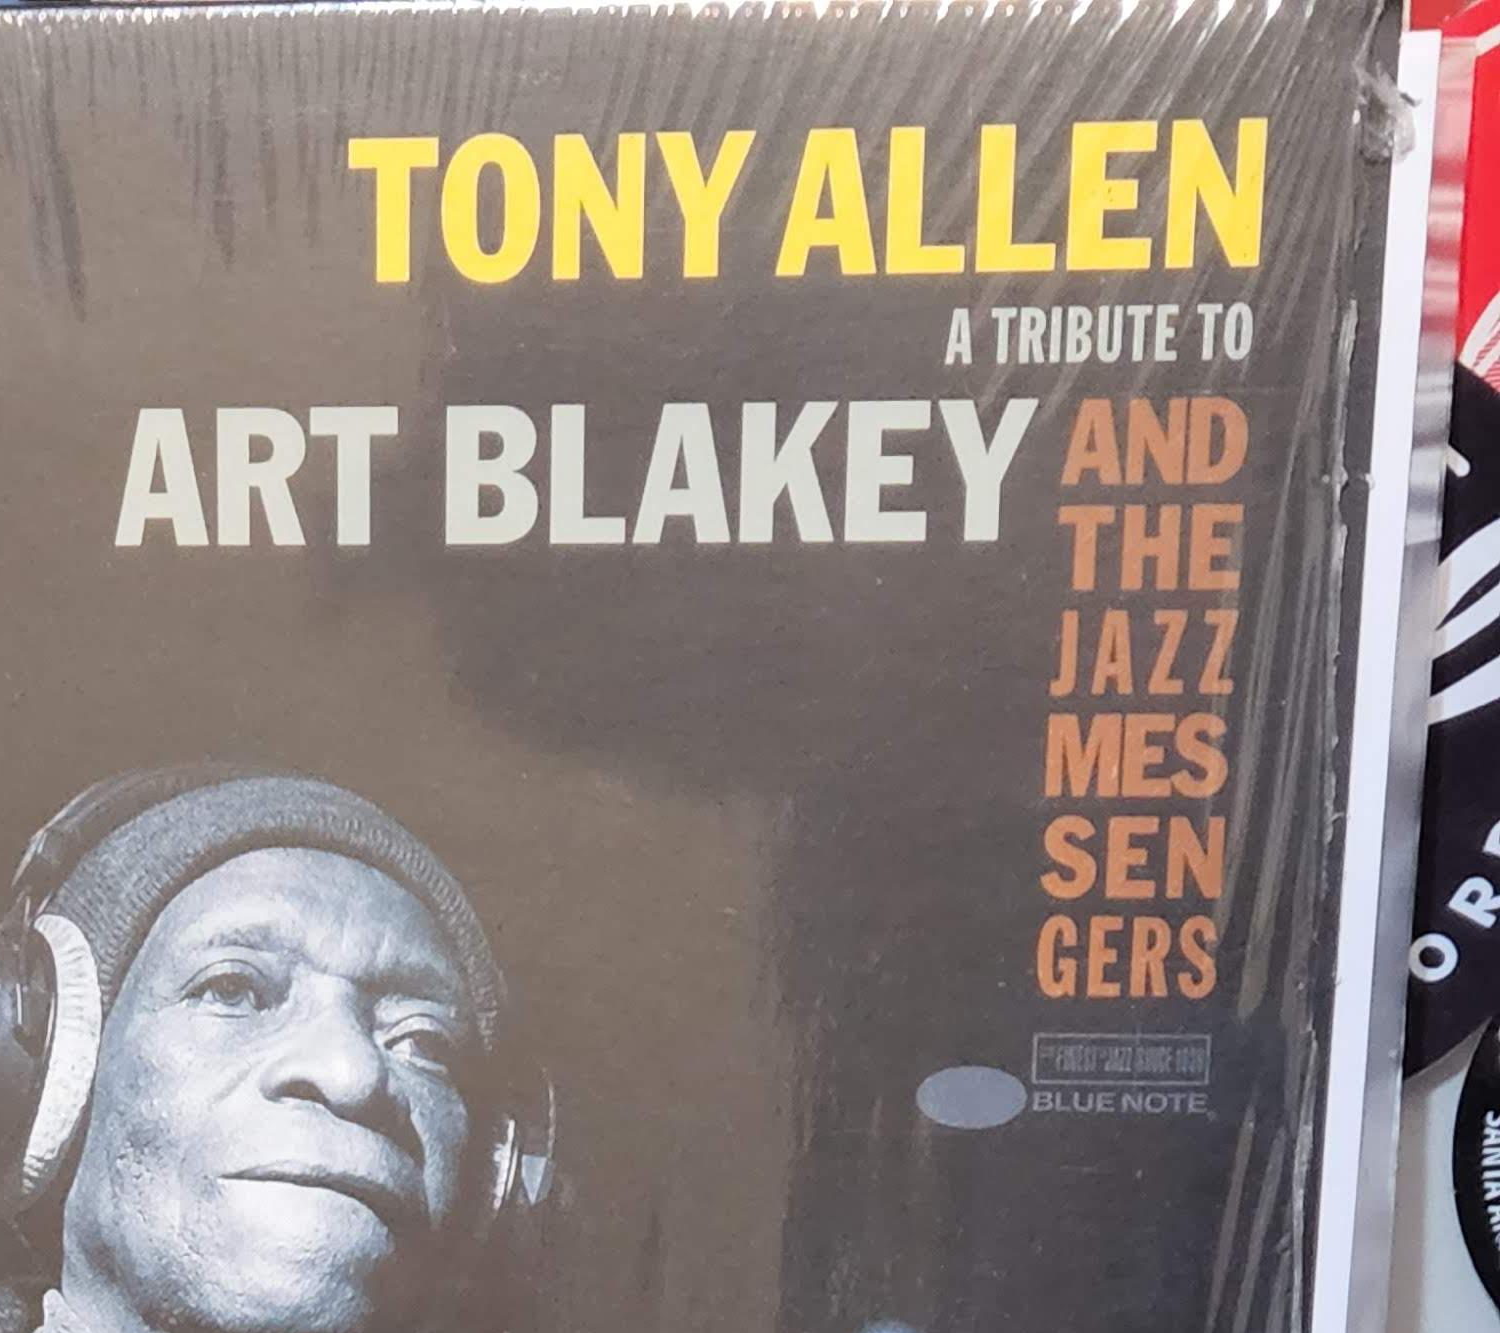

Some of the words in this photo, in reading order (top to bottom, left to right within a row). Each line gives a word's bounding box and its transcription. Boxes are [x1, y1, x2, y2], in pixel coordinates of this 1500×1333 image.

[349, 130, 756, 283] TONY
[776, 116, 1268, 277] ALLEN
[945, 307, 974, 365] A
[991, 304, 1177, 364] TRIBUTE
[1197, 302, 1254, 361] TO
[113, 403, 399, 547] ART
[446, 395, 1039, 545] BLAKEY
[1060, 396, 1249, 486] AND
[1058, 503, 1244, 592] THE
[1049, 608, 1239, 697] JAZZ
[1043, 711, 1230, 799] MES
[1040, 814, 1227, 901] SEN
[1036, 914, 1218, 1000] GERS
[1033, 1092, 1115, 1112] BLUE
[1121, 1092, 1208, 1113] NOTE
